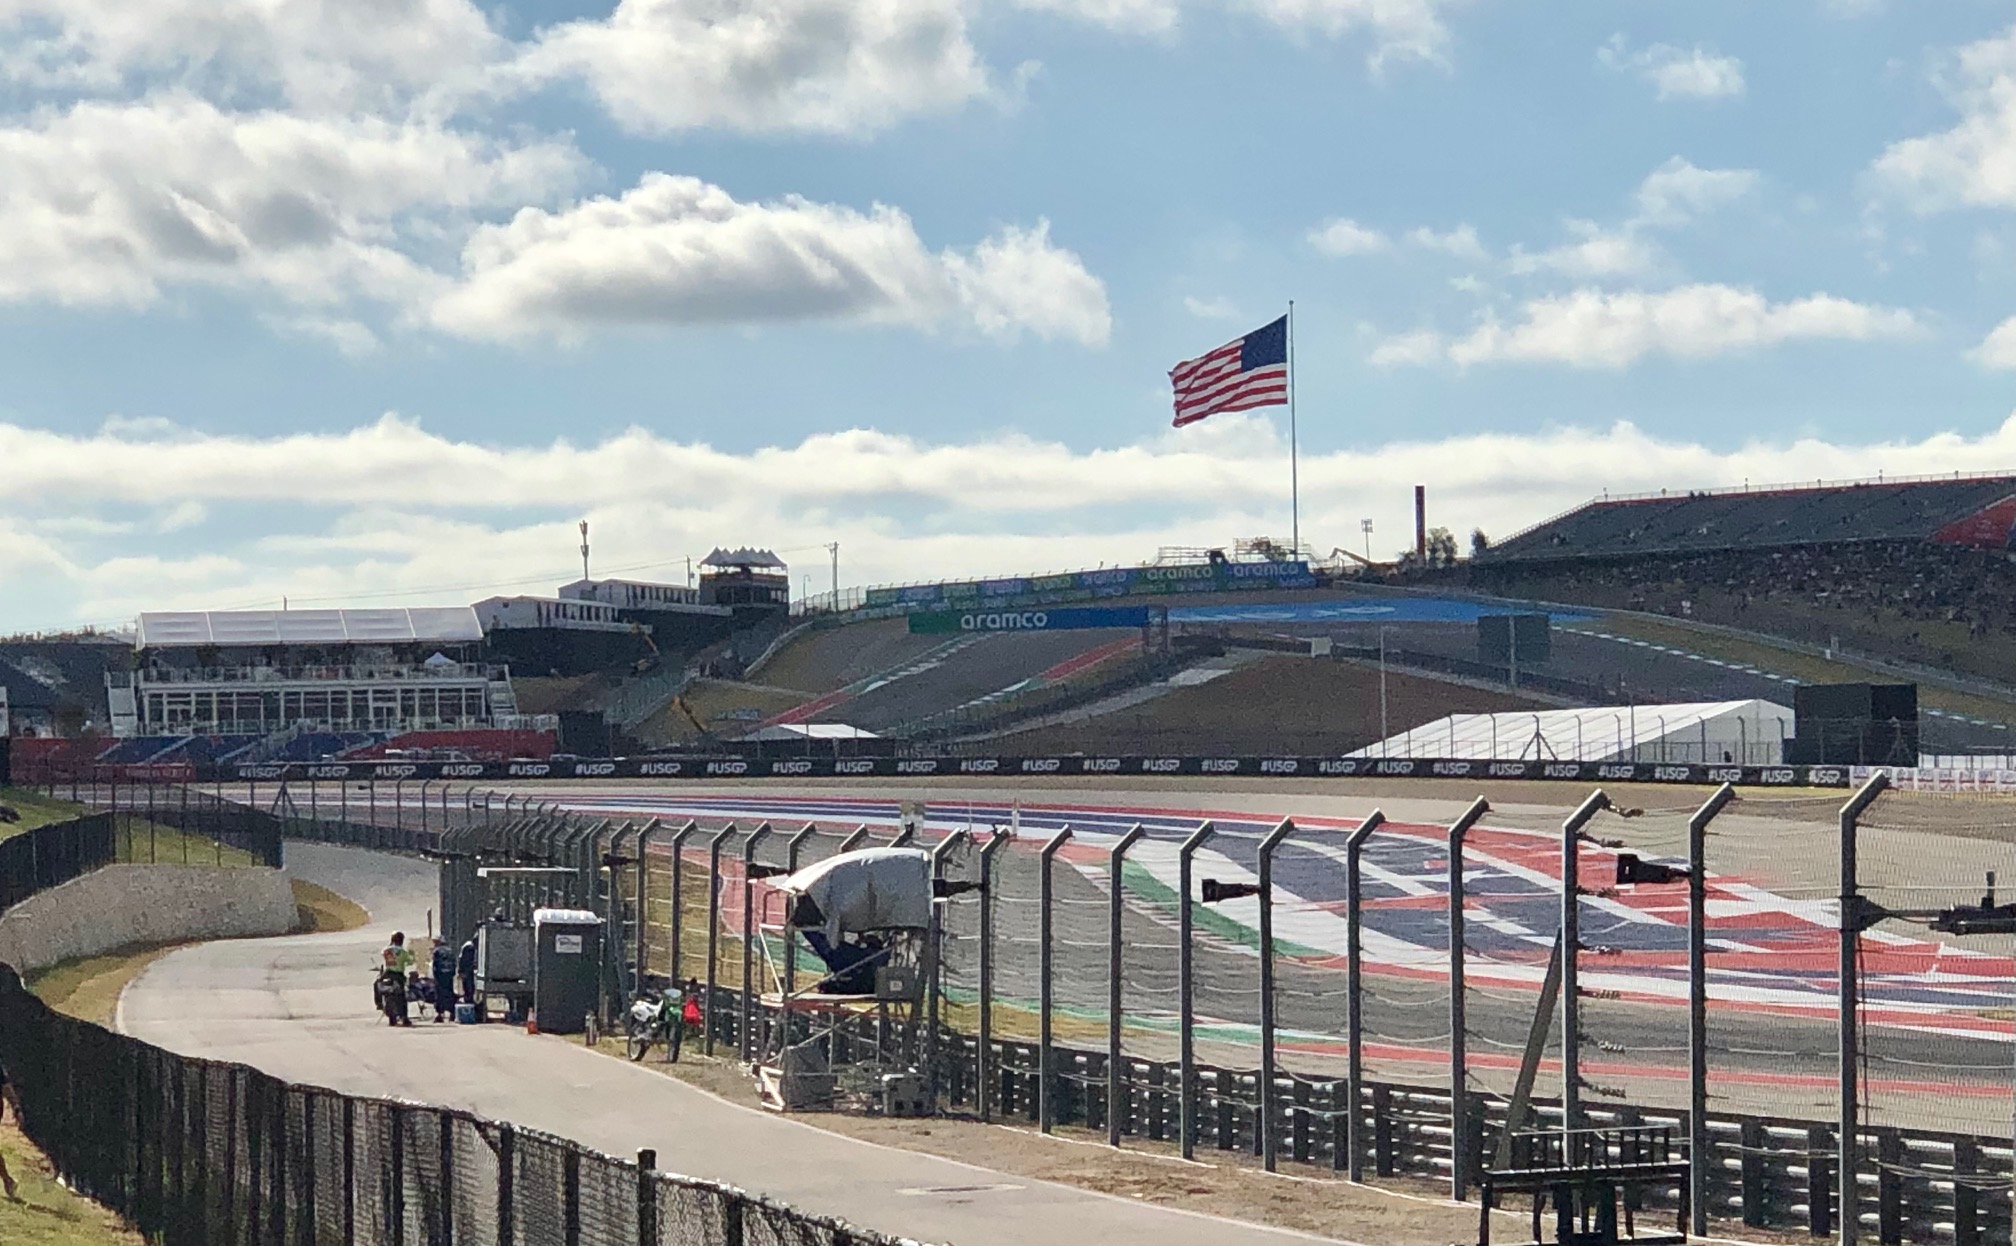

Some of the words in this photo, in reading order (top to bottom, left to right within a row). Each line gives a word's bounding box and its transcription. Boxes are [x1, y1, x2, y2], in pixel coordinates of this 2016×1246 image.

[1147, 566, 1213, 580] aramco
[1234, 563, 1300, 577] aramco
[961, 612, 1049, 630] aramco
[442, 765, 483, 775] #USGP
[510, 765, 549, 775] #USGP
[576, 764, 614, 774] #USGP
[641, 763, 680, 774] #USGP
[708, 763, 747, 773] #USGP
[773, 762, 811, 773] #USGP
[836, 762, 873, 772] #USGP
[898, 761, 936, 772] #USGP
[961, 760, 998, 771] #USGP
[1023, 760, 1059, 771] #USGP
[1083, 759, 1120, 770] #USGP
[1143, 760, 1179, 770] #USGP
[1202, 760, 1238, 771] #USGP
[1261, 761, 1297, 772] #USGP
[1319, 761, 1355, 772] #USGP
[1378, 762, 1413, 773] #USGP
[1434, 763, 1470, 774] #USGP
[1489, 764, 1524, 775] #USGP
[308, 766, 349, 776] #USGP
[376, 766, 416, 777] #USGP
[1544, 765, 1579, 777] #USGP
[1598, 765, 1634, 777] #USGP
[1655, 767, 1689, 779] #USGP
[1709, 769, 1741, 781] #USGP
[1761, 770, 1793, 782] #USGP
[1809, 770, 1840, 783] #USGP
